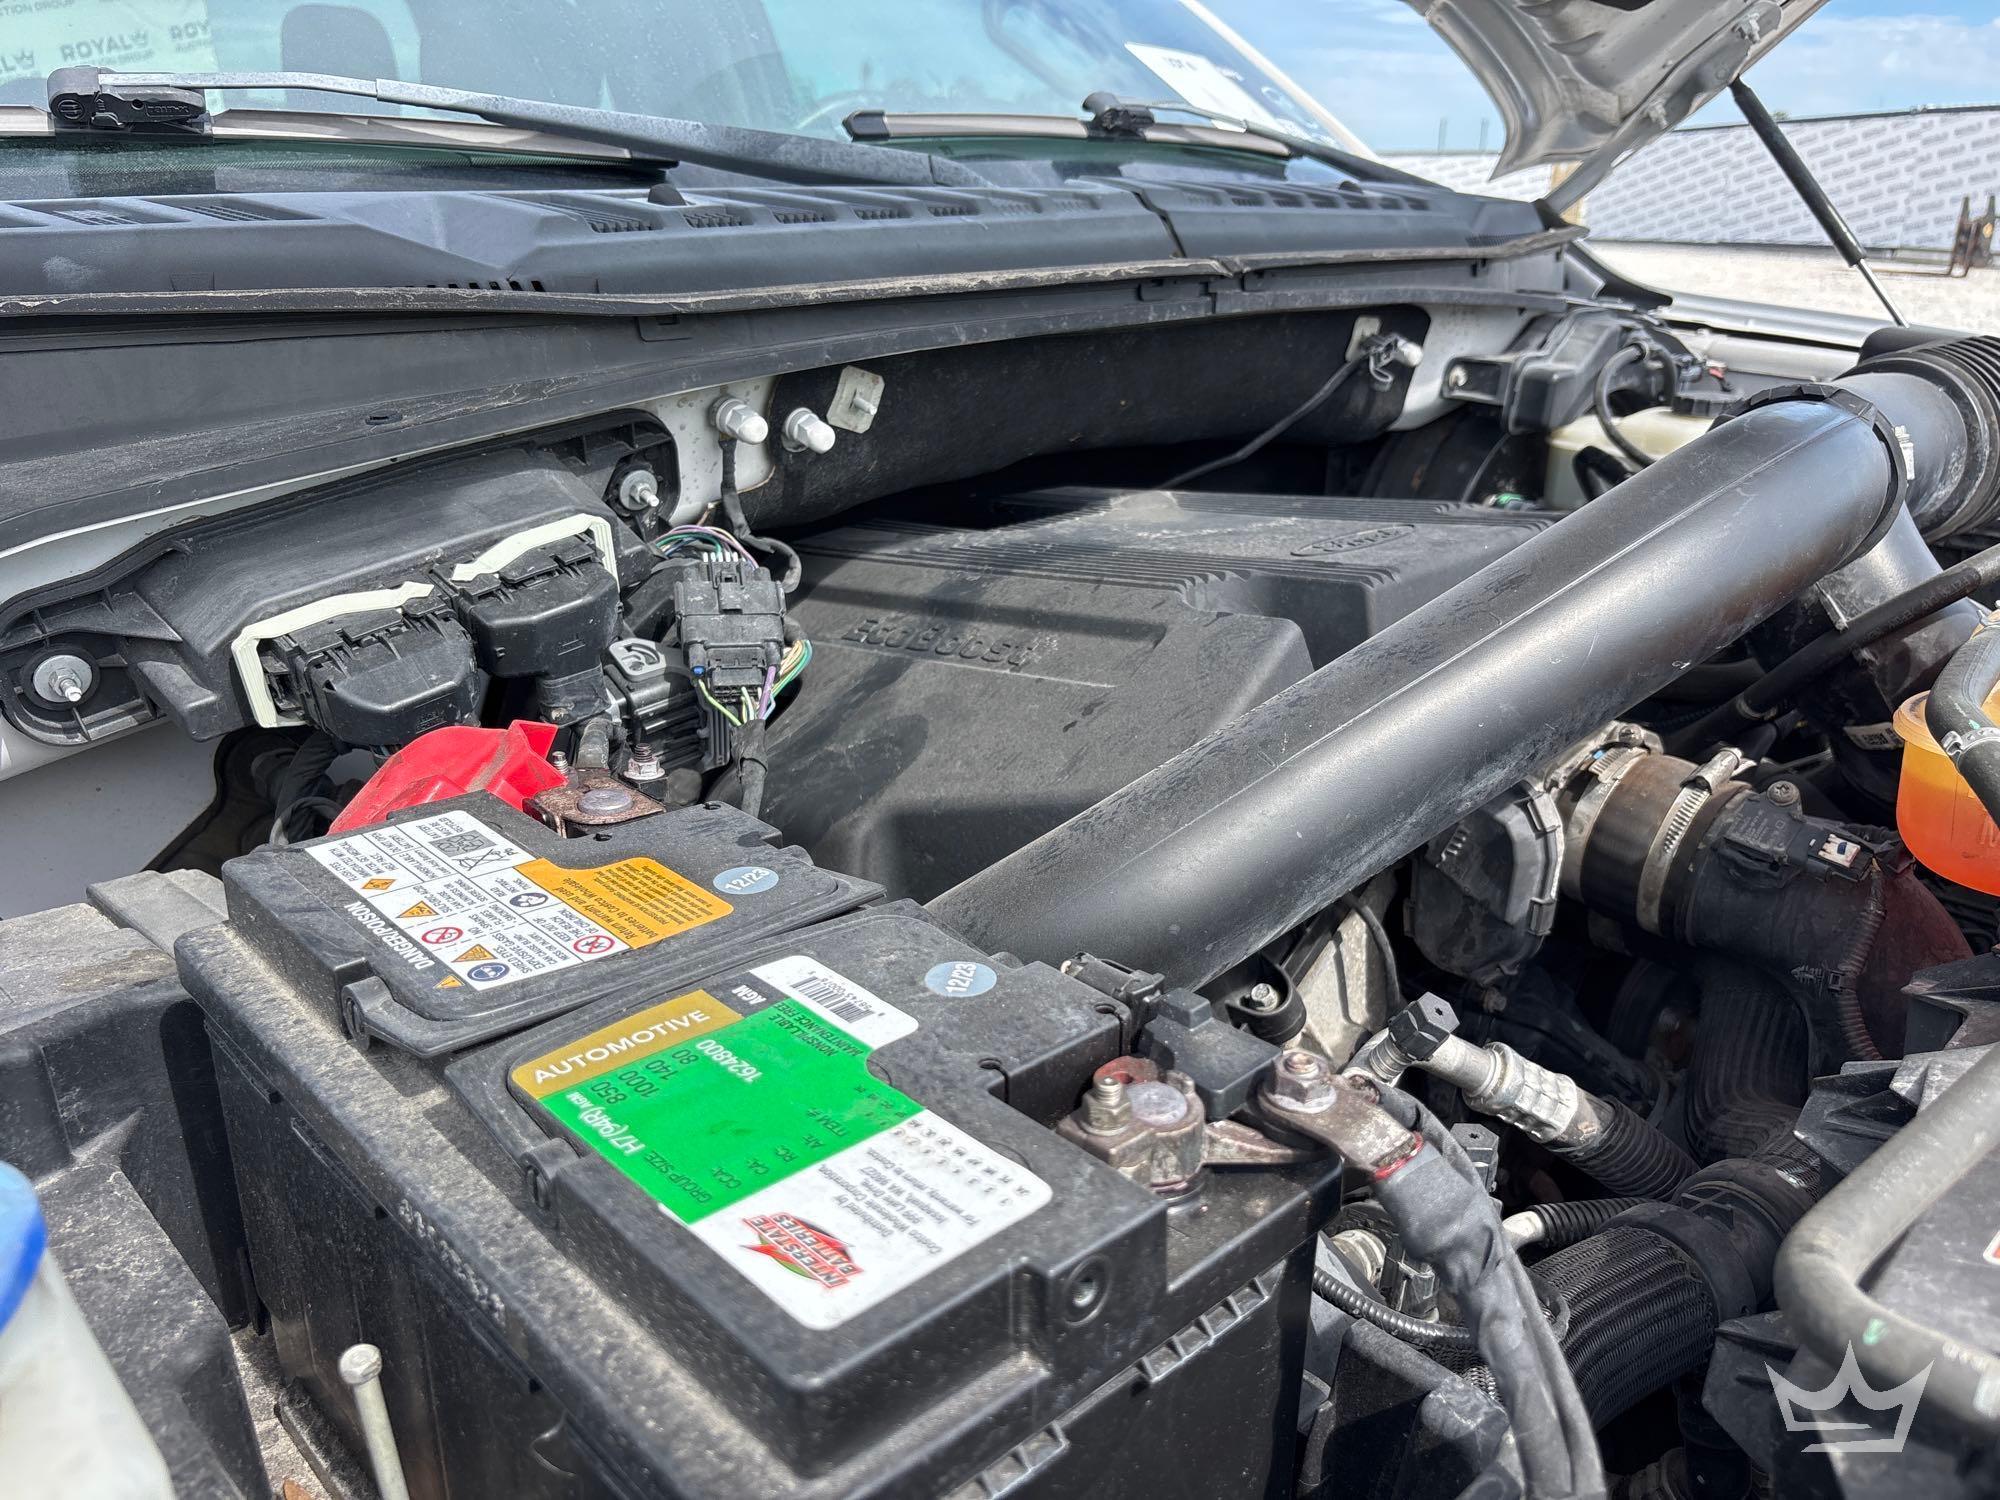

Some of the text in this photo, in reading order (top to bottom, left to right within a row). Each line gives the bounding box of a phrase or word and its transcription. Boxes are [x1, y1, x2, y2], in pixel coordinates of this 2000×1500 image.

[61, 33, 132, 62] ROYAL
[558, 877, 598, 898] Wholesale
[725, 868, 770, 891] 12/23
[552, 886, 639, 939] Return warranty and used
[590, 897, 621, 912] Costco
[341, 900, 437, 970] DANGER/POISON
[618, 916, 662, 938] batteries
[945, 963, 977, 993] 12/23
[729, 984, 767, 1005] AGM
[767, 1012, 838, 1056] NONSPILLABLE
[772, 1001, 863, 1057] MAINTENANCE FREE
[533, 1009, 711, 1083] AUTOMOTIVE
[669, 1048, 701, 1066] 80
[694, 1037, 765, 1083] 1624800
[616, 1069, 662, 1098] 1000
[642, 1058, 681, 1081] 140
[565, 1090, 594, 1110] AGM
[588, 1079, 629, 1105] 850
[576, 1103, 650, 1155] H7(94R)
[816, 1115, 851, 1137] ITEM
[667, 1170, 713, 1204] GROUP
[750, 1215, 844, 1287] INTERSTATE
[772, 1212, 856, 1275] BATTERIES
